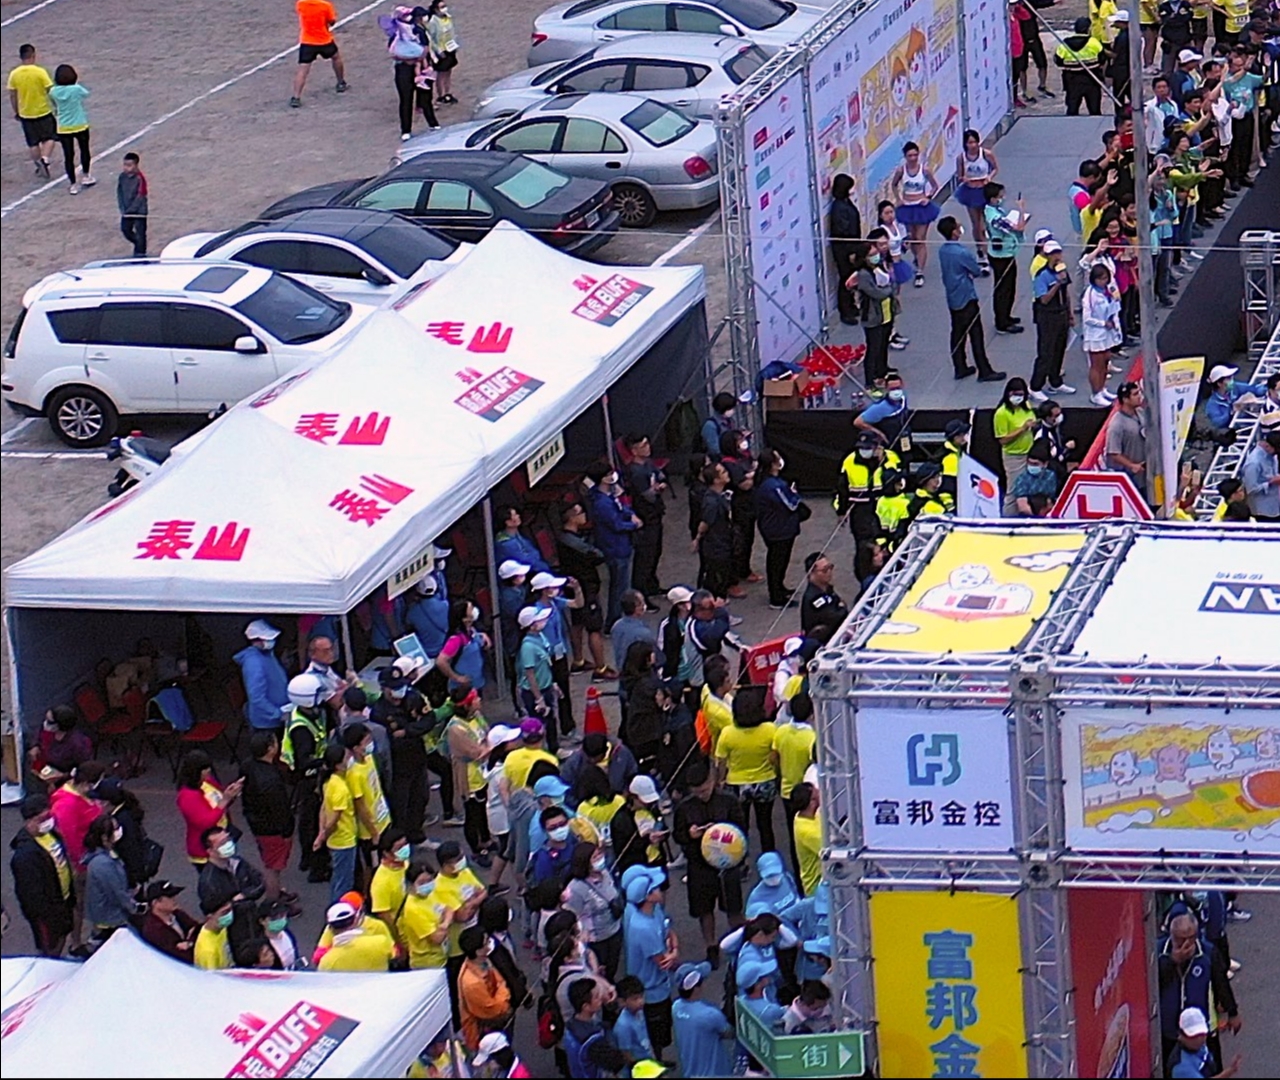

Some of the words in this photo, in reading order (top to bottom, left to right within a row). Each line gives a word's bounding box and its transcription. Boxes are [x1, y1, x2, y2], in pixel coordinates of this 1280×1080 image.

[599, 275, 633, 304] BUFF
[482, 368, 522, 399] BUFF
[294, 411, 392, 446] 泰山
[328, 472, 415, 528] 泰山
[132, 518, 252, 562] 泰山
[872, 799, 1002, 827] 富邦金控
[922, 929, 982, 1079] 富邦金
[265, 1001, 324, 1064] BUFF
